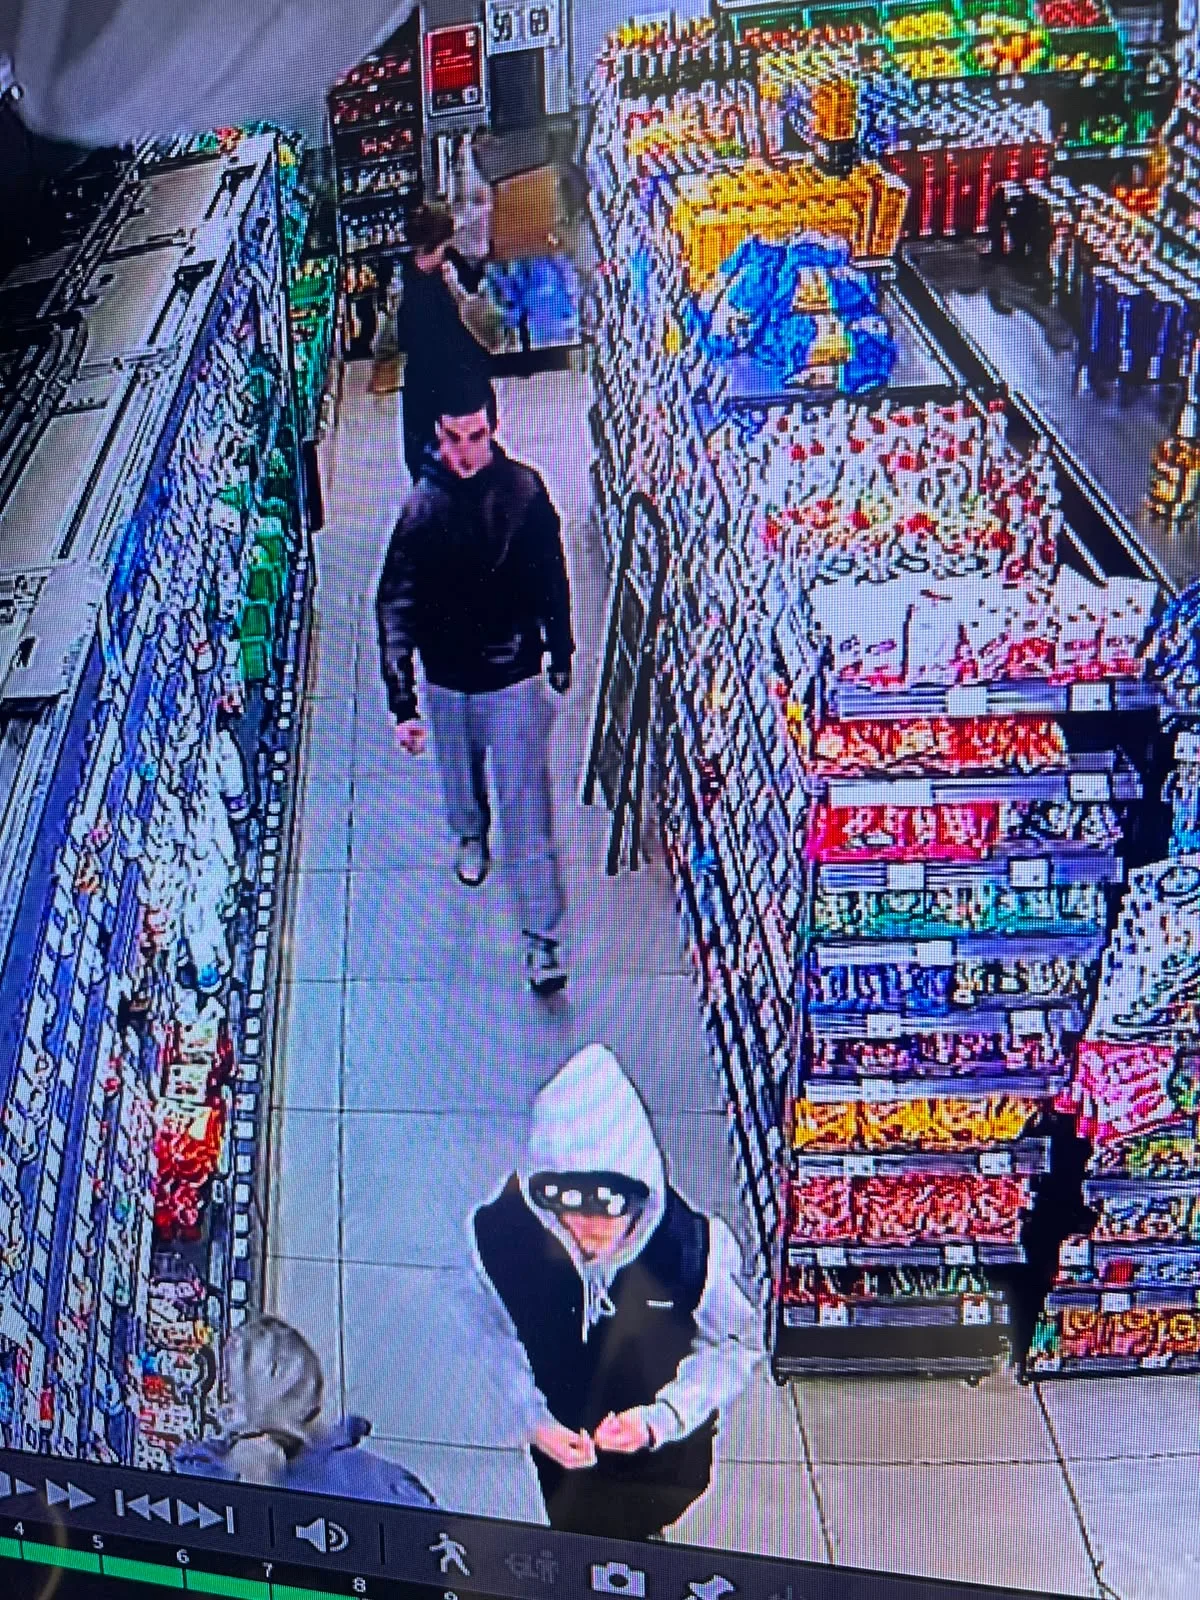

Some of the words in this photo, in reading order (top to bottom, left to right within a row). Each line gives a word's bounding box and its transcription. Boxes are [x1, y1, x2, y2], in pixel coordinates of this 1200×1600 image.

[14, 1521, 25, 1536] 4
[92, 1534, 104, 1549] 5
[176, 1548, 190, 1564] 6
[263, 1562, 273, 1578] 7
[352, 1576, 366, 1592] 8
